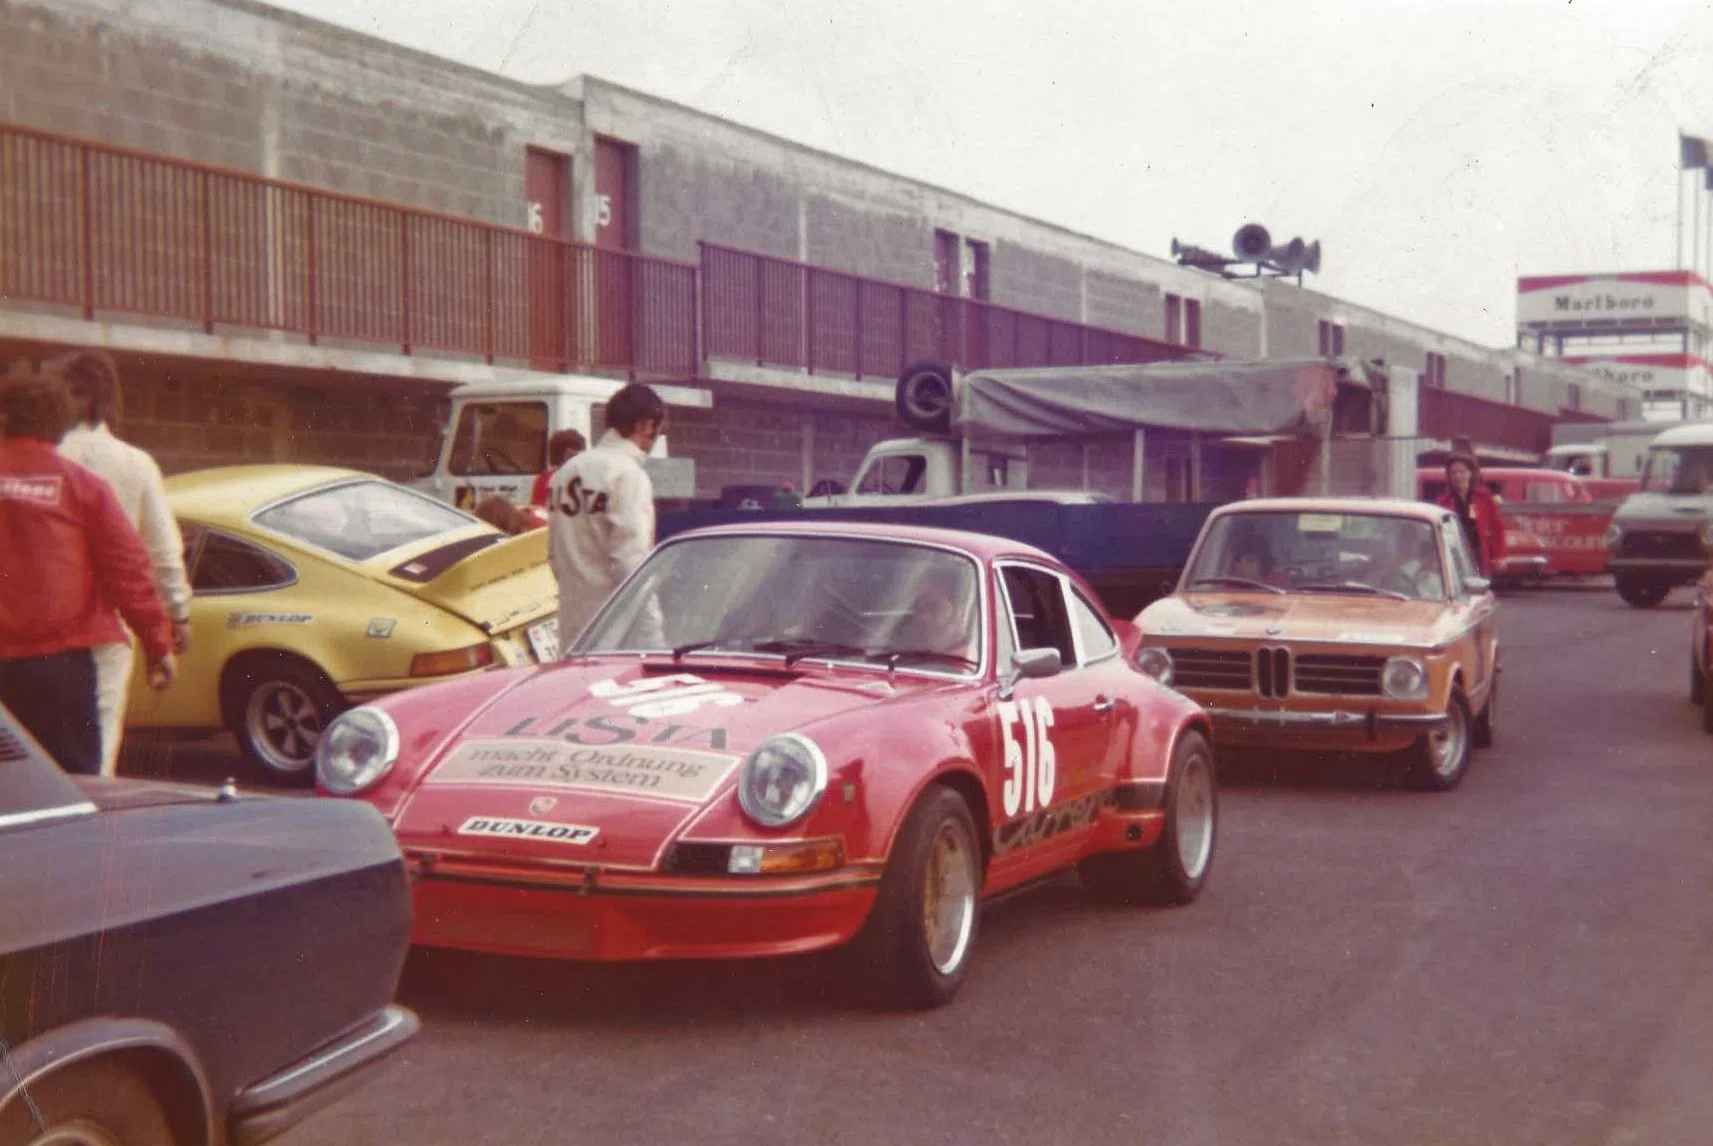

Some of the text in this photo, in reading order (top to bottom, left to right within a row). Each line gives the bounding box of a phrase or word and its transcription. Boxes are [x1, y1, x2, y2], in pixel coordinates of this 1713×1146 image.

[1554, 294, 1655, 311] Marlboro
[504, 716, 727, 751] LISTA
[470, 748, 706, 779] macht Ordnung
[996, 695, 1056, 817] 516
[477, 762, 661, 788] zum System
[468, 820, 592, 840] DUNLOP
